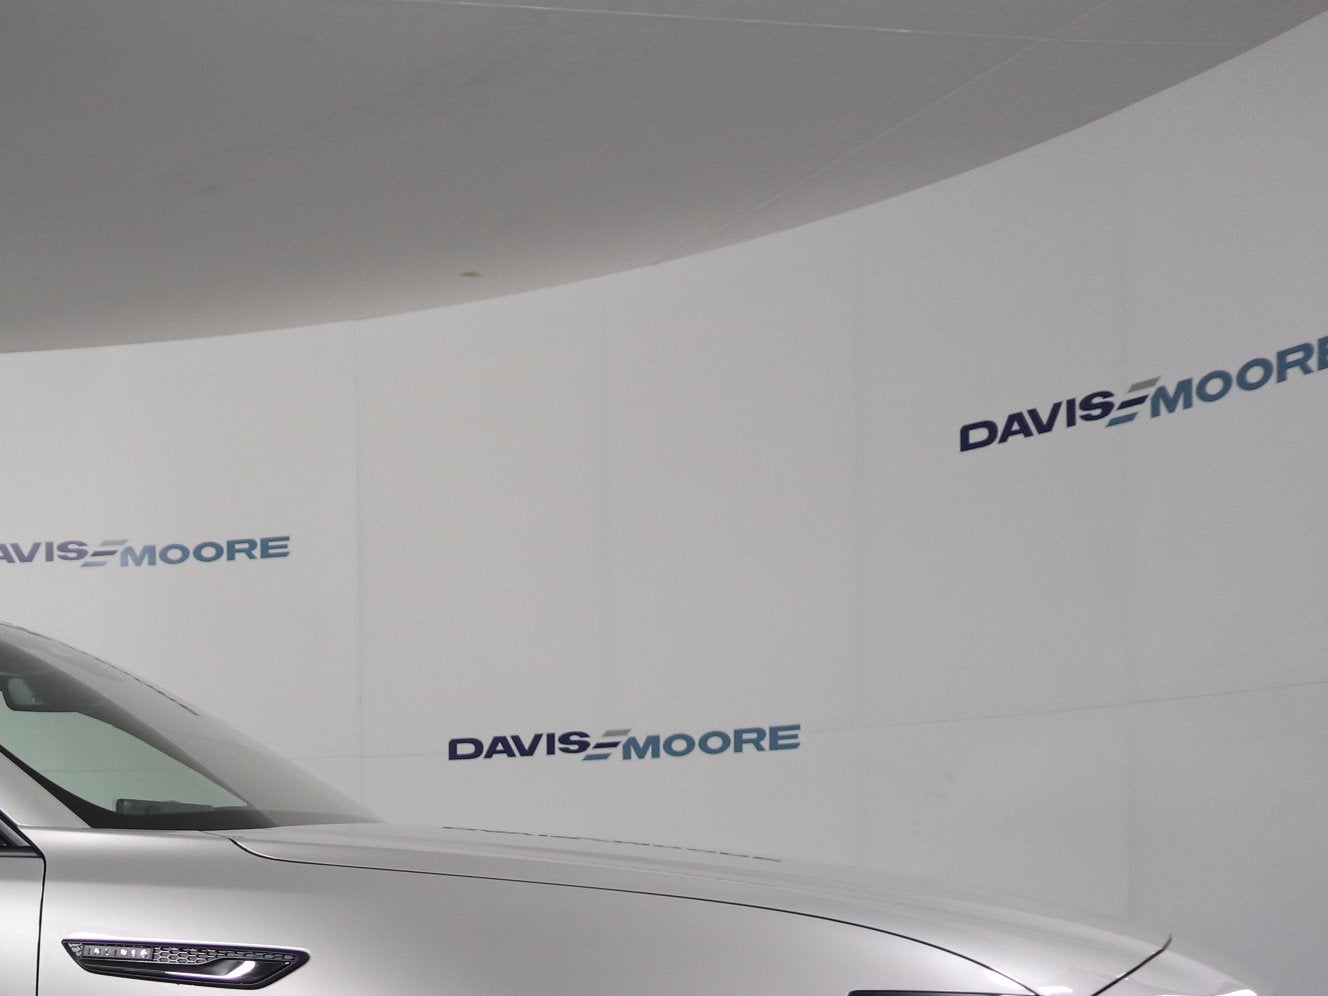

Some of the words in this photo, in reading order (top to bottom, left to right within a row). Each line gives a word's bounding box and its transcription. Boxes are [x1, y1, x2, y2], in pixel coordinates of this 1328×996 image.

[959, 390, 1115, 452] DAVIS
[1150, 335, 1328, 419] MOOR
[119, 535, 291, 568] MOORE
[448, 731, 591, 761] DAVIS
[621, 723, 802, 761] MOORE
